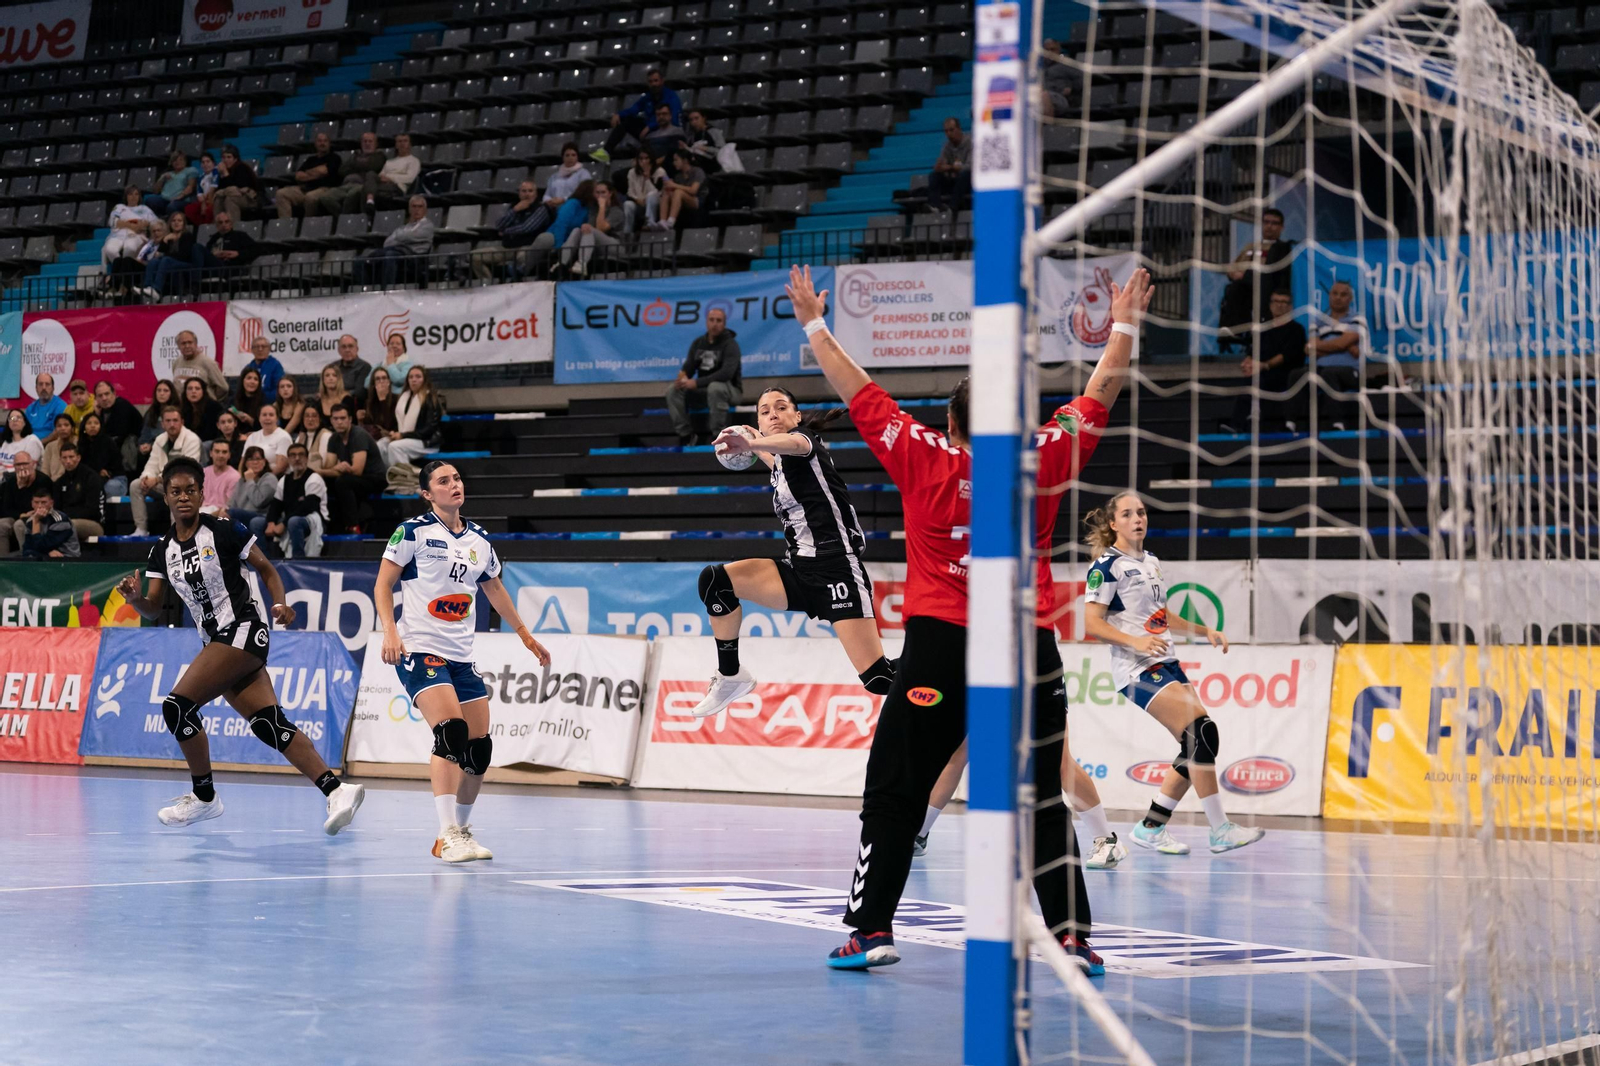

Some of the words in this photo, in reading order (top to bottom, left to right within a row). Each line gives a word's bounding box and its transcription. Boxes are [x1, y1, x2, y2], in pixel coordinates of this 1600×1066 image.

[237, 6, 286, 21] vermell
[0, 18, 76, 64] we
[562, 296, 829, 329] LENOBOTIC
[873, 313, 928, 324] PERMISOS
[931, 313, 944, 322] DE
[948, 312, 971, 322] CON
[268, 317, 343, 334] Generalitat
[412, 312, 538, 351] esportcat
[952, 328, 966, 339] DE
[1036, 325, 1056, 335] MIS
[24, 343, 43, 354] ENTRE
[159, 347, 179, 358] TOTES
[270, 339, 285, 353] de
[289, 337, 340, 352] Catalun
[873, 347, 915, 357] CURSOS
[919, 346, 940, 356] CAP
[949, 344, 971, 355] ADR
[23, 354, 41, 364] TOTES
[44, 352, 67, 364] ESPORT
[100, 360, 135, 372] esportcat
[565, 360, 575, 370] La
[577, 361, 593, 370] teva
[595, 359, 621, 371] botiga
[624, 357, 680, 369] especialitzada
[741, 353, 770, 363] ucativa
[778, 350, 791, 361] oci
[184, 555, 201, 575] 45
[449, 562, 467, 583] 42
[827, 582, 848, 601] 10
[1152, 585, 1160, 602] 17
[709, 612, 832, 637] OYS
[359, 683, 392, 695] cacions
[482, 664, 642, 713] stabane
[356, 698, 368, 707] tat
[353, 710, 380, 721] sables
[661, 691, 874, 737] SPAR
[1426, 686, 1600, 759] FRAI
[538, 718, 592, 741] millor
[1232, 764, 1285, 782] frinca
